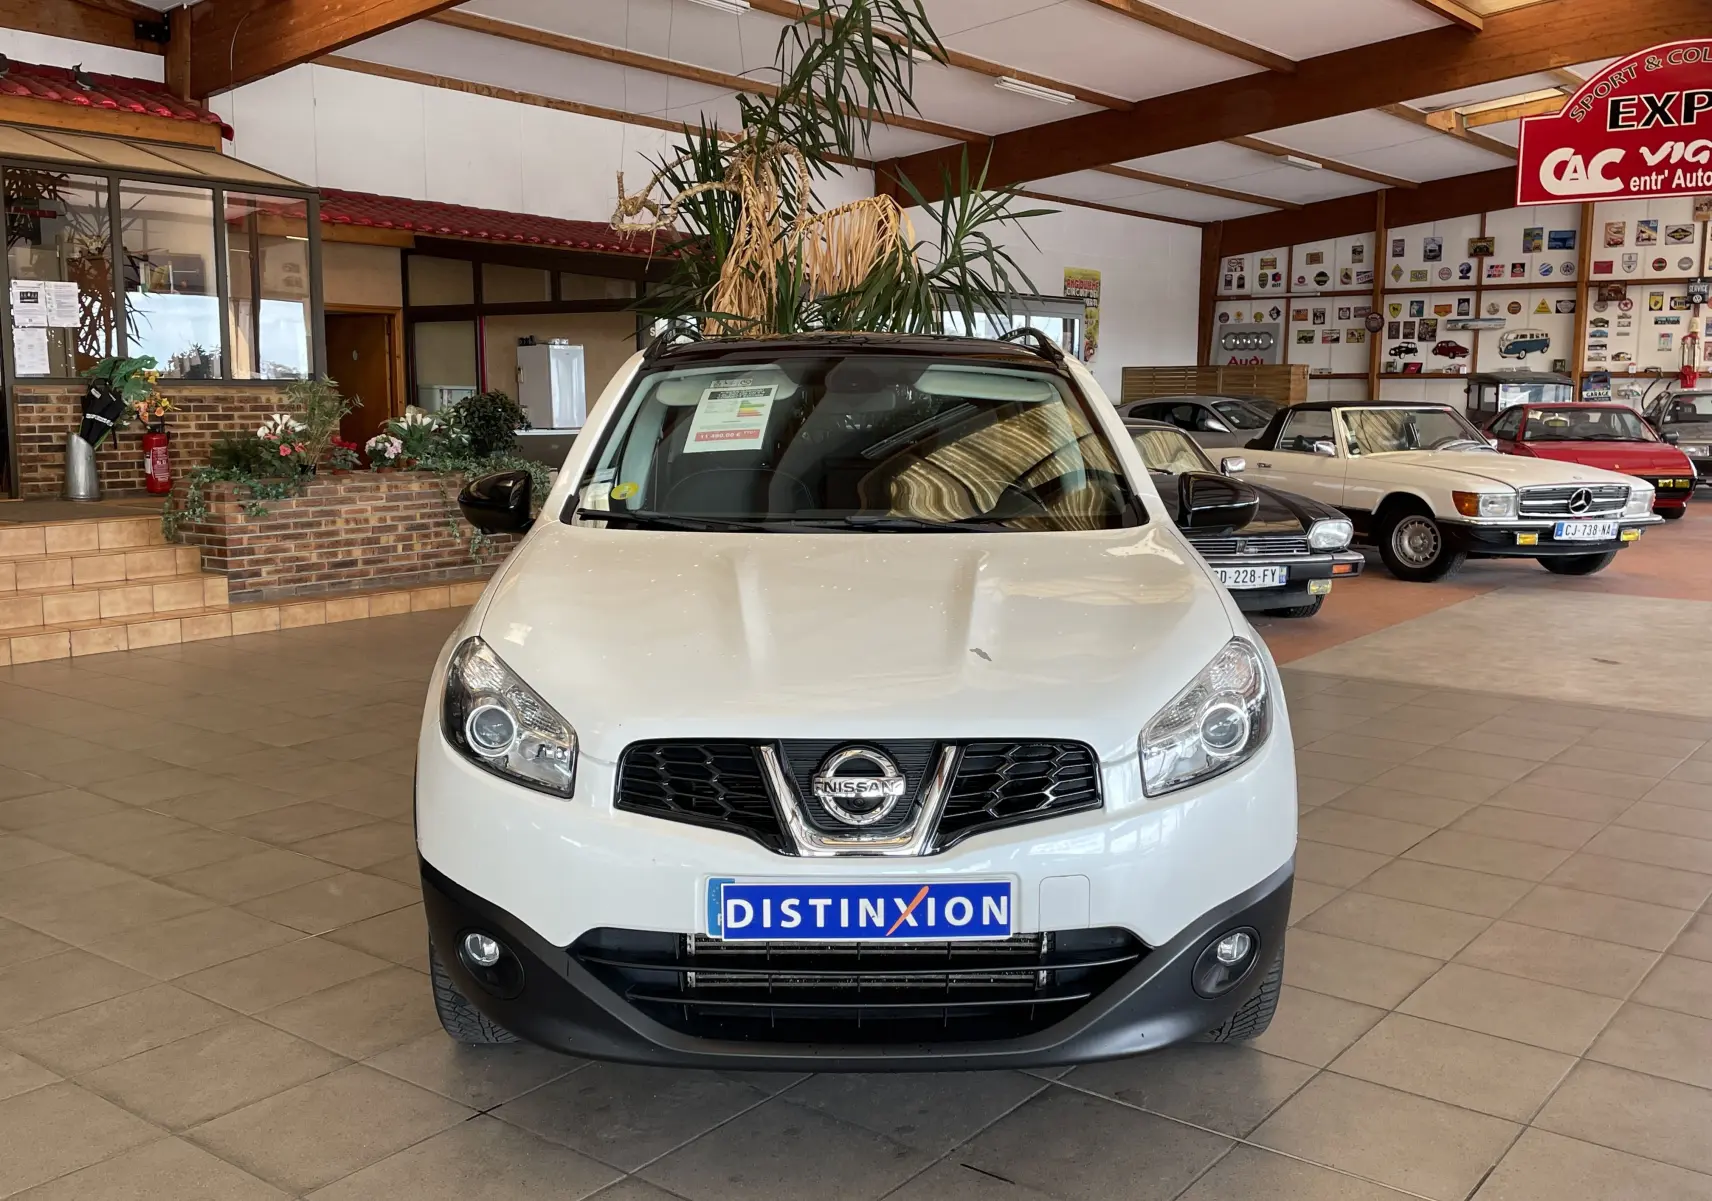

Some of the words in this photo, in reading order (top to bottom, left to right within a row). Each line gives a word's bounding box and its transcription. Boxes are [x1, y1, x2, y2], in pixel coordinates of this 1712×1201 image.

[1569, 62, 1638, 122] SPORT
[1644, 55, 1663, 71] &
[1606, 89, 1712, 132] EXP
[1630, 170, 1669, 192] entr'
[1565, 524, 1611, 536] CJ-738-NA
[823, 781, 894, 793] NISSAN
[726, 887, 1008, 936] DISTINXION
